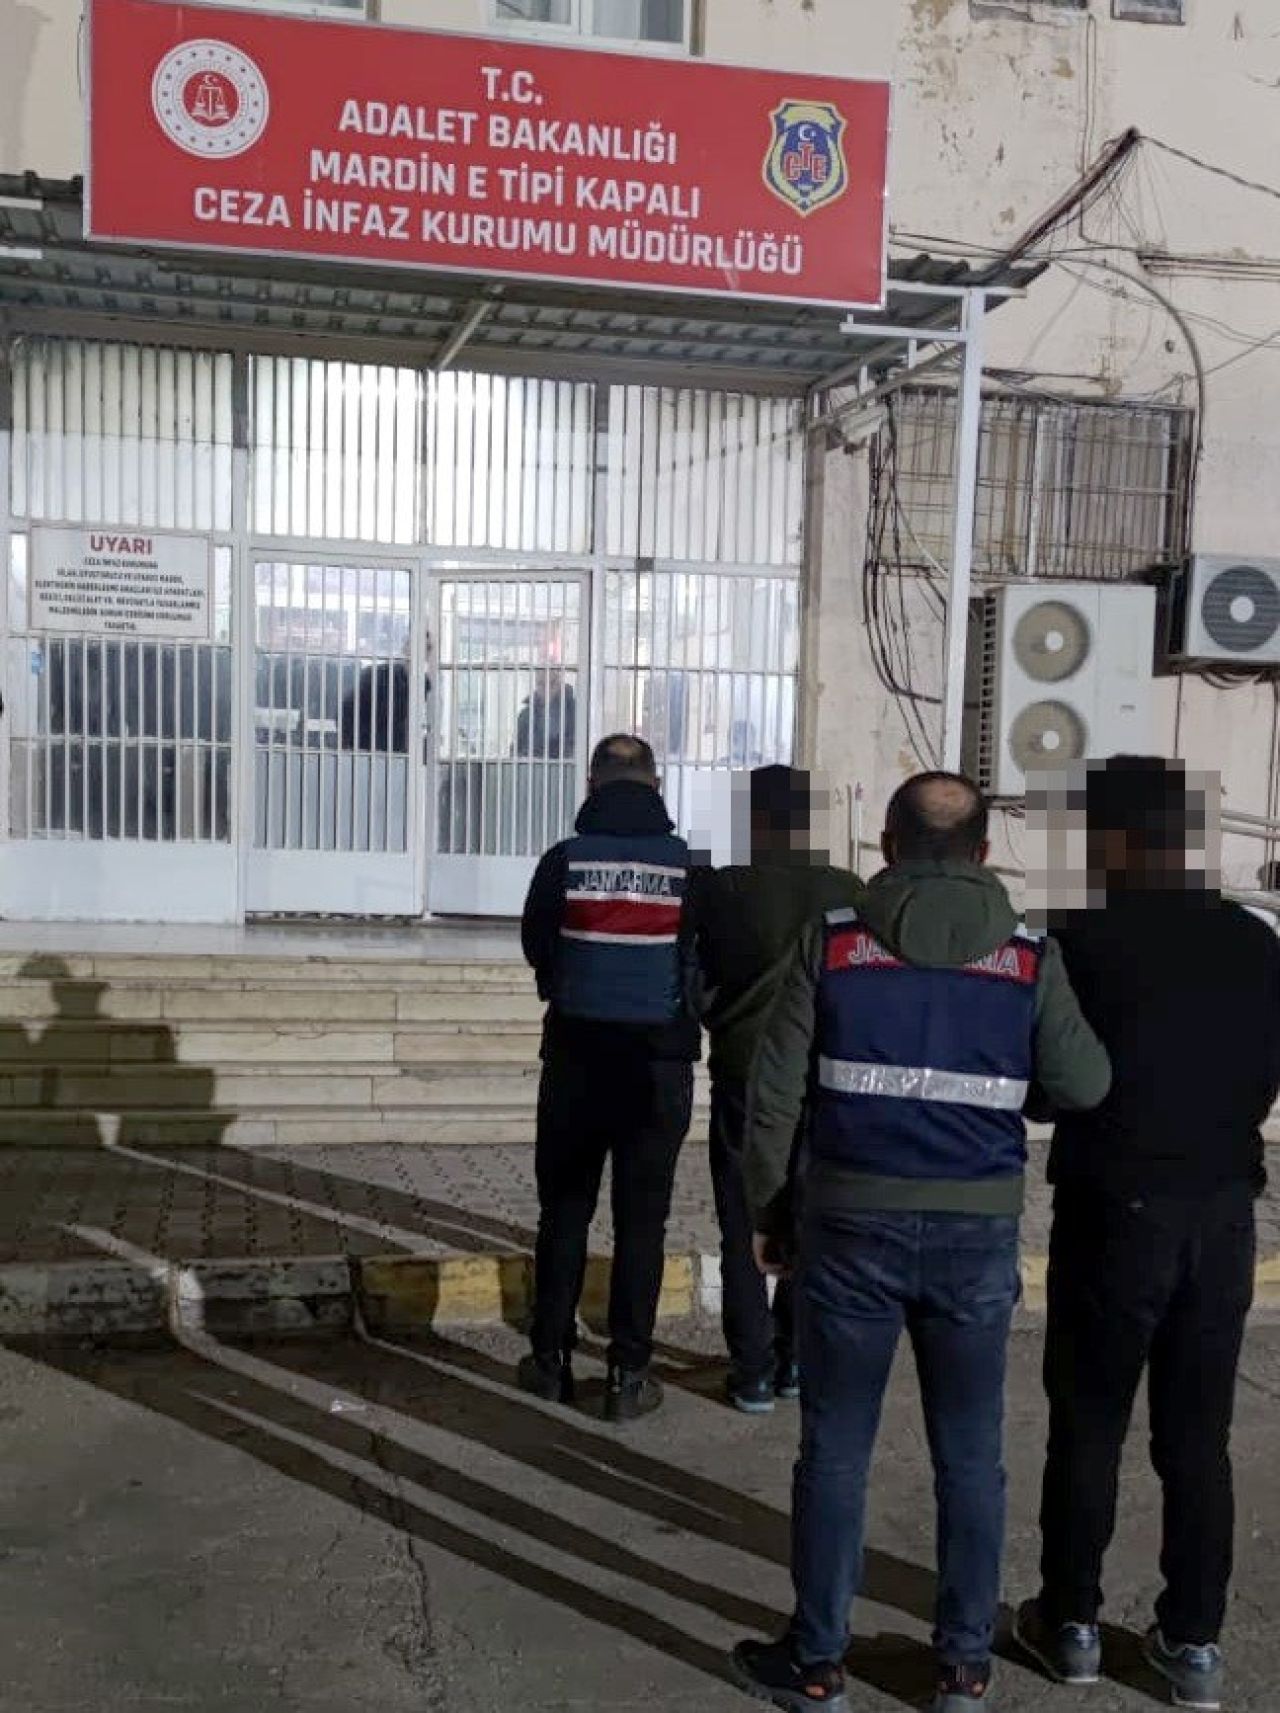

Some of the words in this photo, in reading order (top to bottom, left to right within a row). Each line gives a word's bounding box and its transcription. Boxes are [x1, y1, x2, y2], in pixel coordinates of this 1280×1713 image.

[481, 66, 544, 105] T.C.
[338, 98, 479, 144] ADALET
[488, 113, 677, 164] BAKANLIĞI
[309, 149, 456, 196] MARDİN
[467, 164, 488, 198] E
[498, 161, 565, 207] TİPİ
[576, 175, 700, 218] KAPALI
[193, 186, 292, 228] CEZA
[303, 187, 411, 239] İNFAZ
[422, 209, 577, 256] KURUMU
[588, 219, 803, 275] MÜDÜRLÜĞÜ
[90, 534, 154, 555] UYARI
